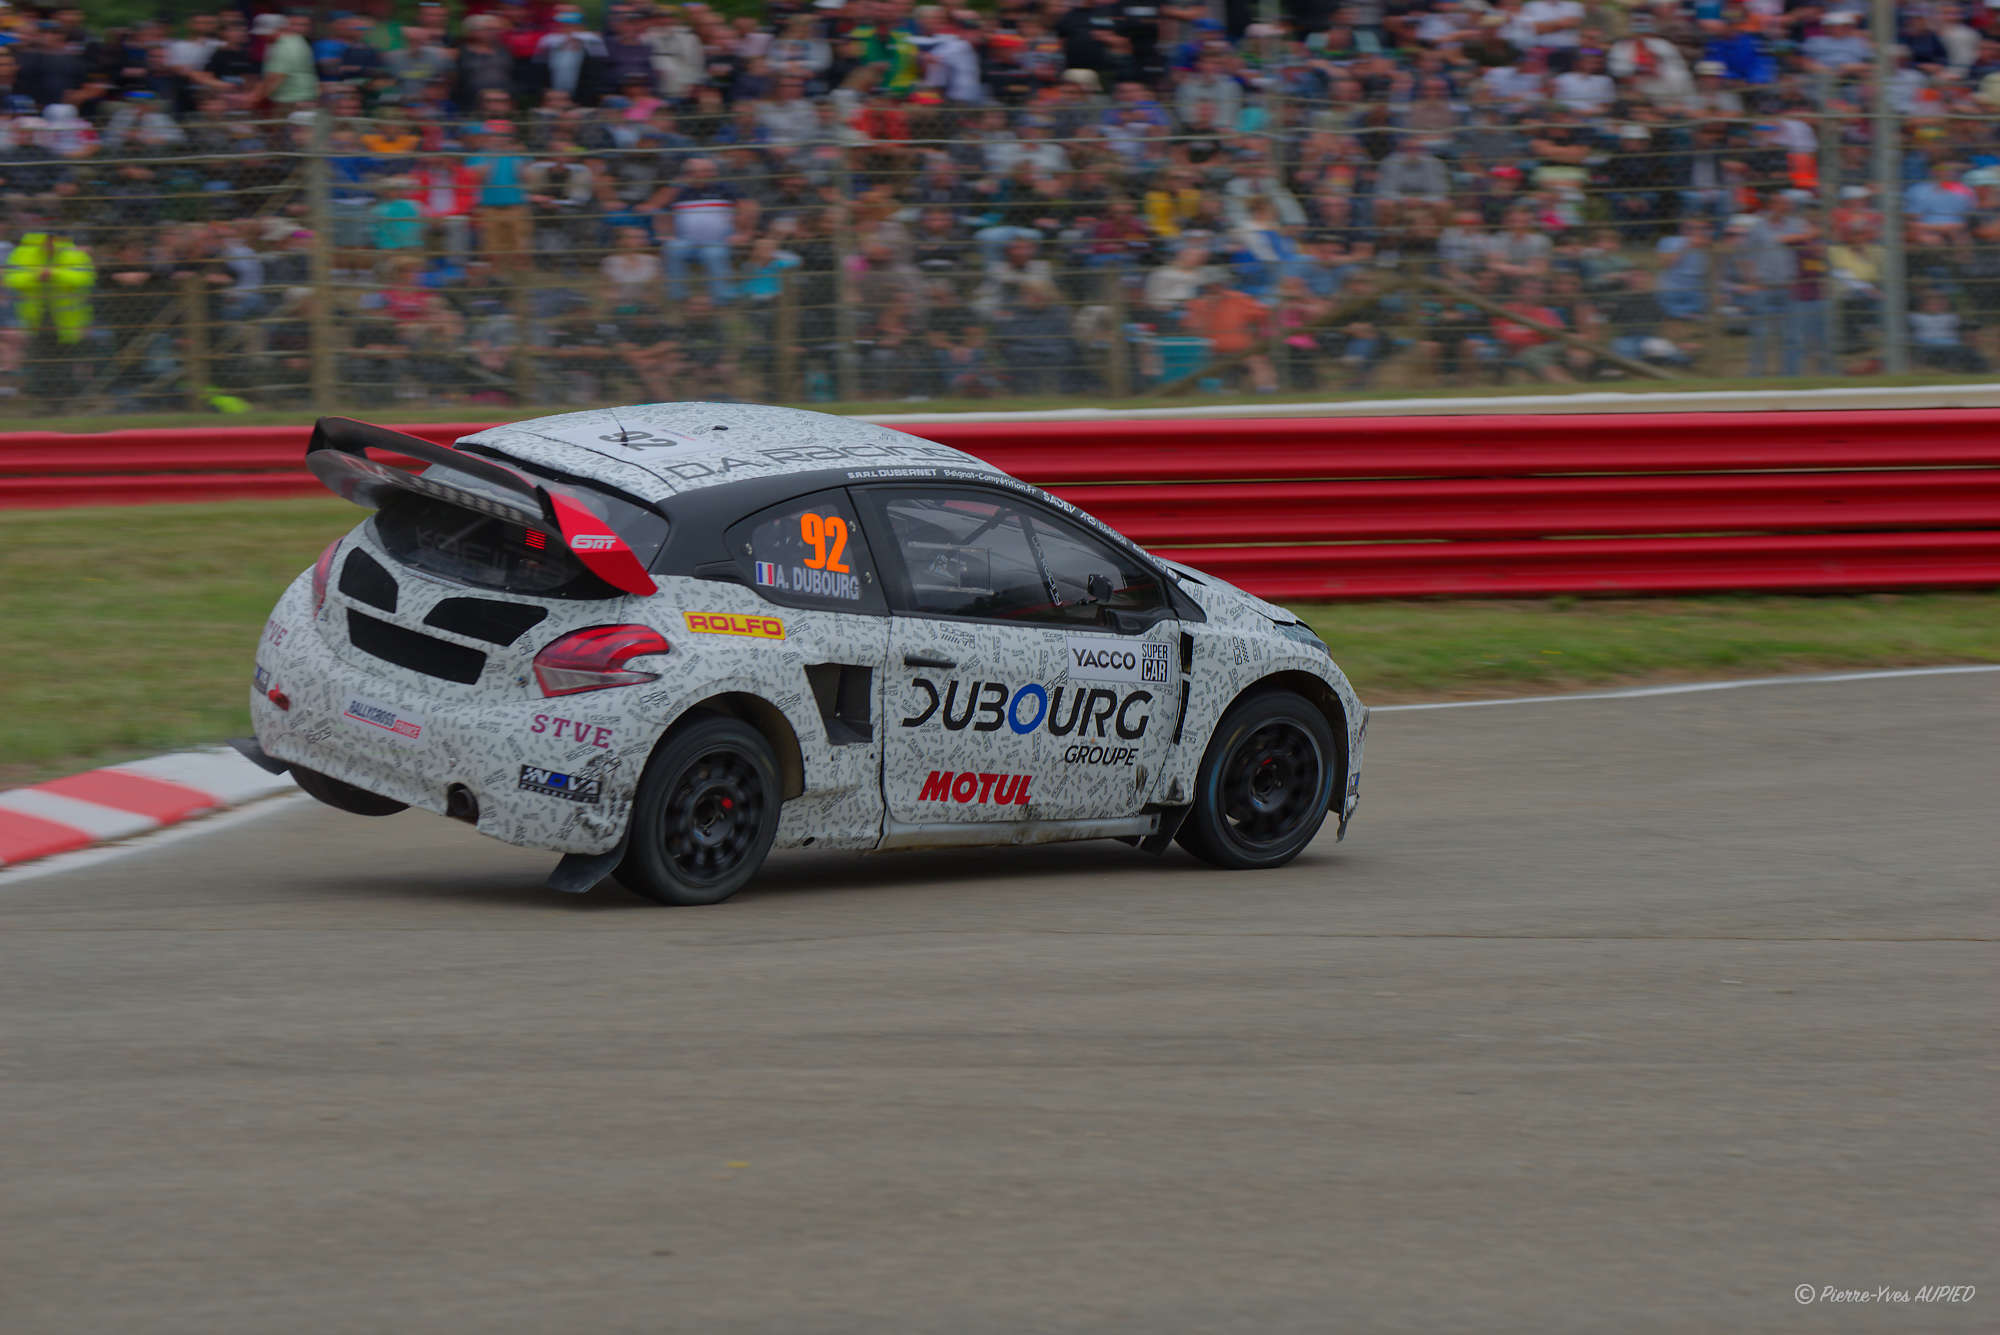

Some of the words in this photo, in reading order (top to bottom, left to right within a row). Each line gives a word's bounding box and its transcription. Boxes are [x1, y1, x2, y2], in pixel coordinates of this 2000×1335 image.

[800, 512, 851, 574] 92
[775, 564, 790, 589] A.
[792, 566, 860, 600] DUBOURG
[688, 614, 783, 636] ROLFO
[1071, 647, 1137, 671] YACCO
[1141, 642, 1169, 660] SUPER
[1143, 660, 1168, 682] CAR
[902, 678, 1154, 740] DUBOURG
[530, 714, 613, 748] STVE
[1064, 744, 1139, 766] GROUPE
[918, 770, 1033, 806] MOTUL
